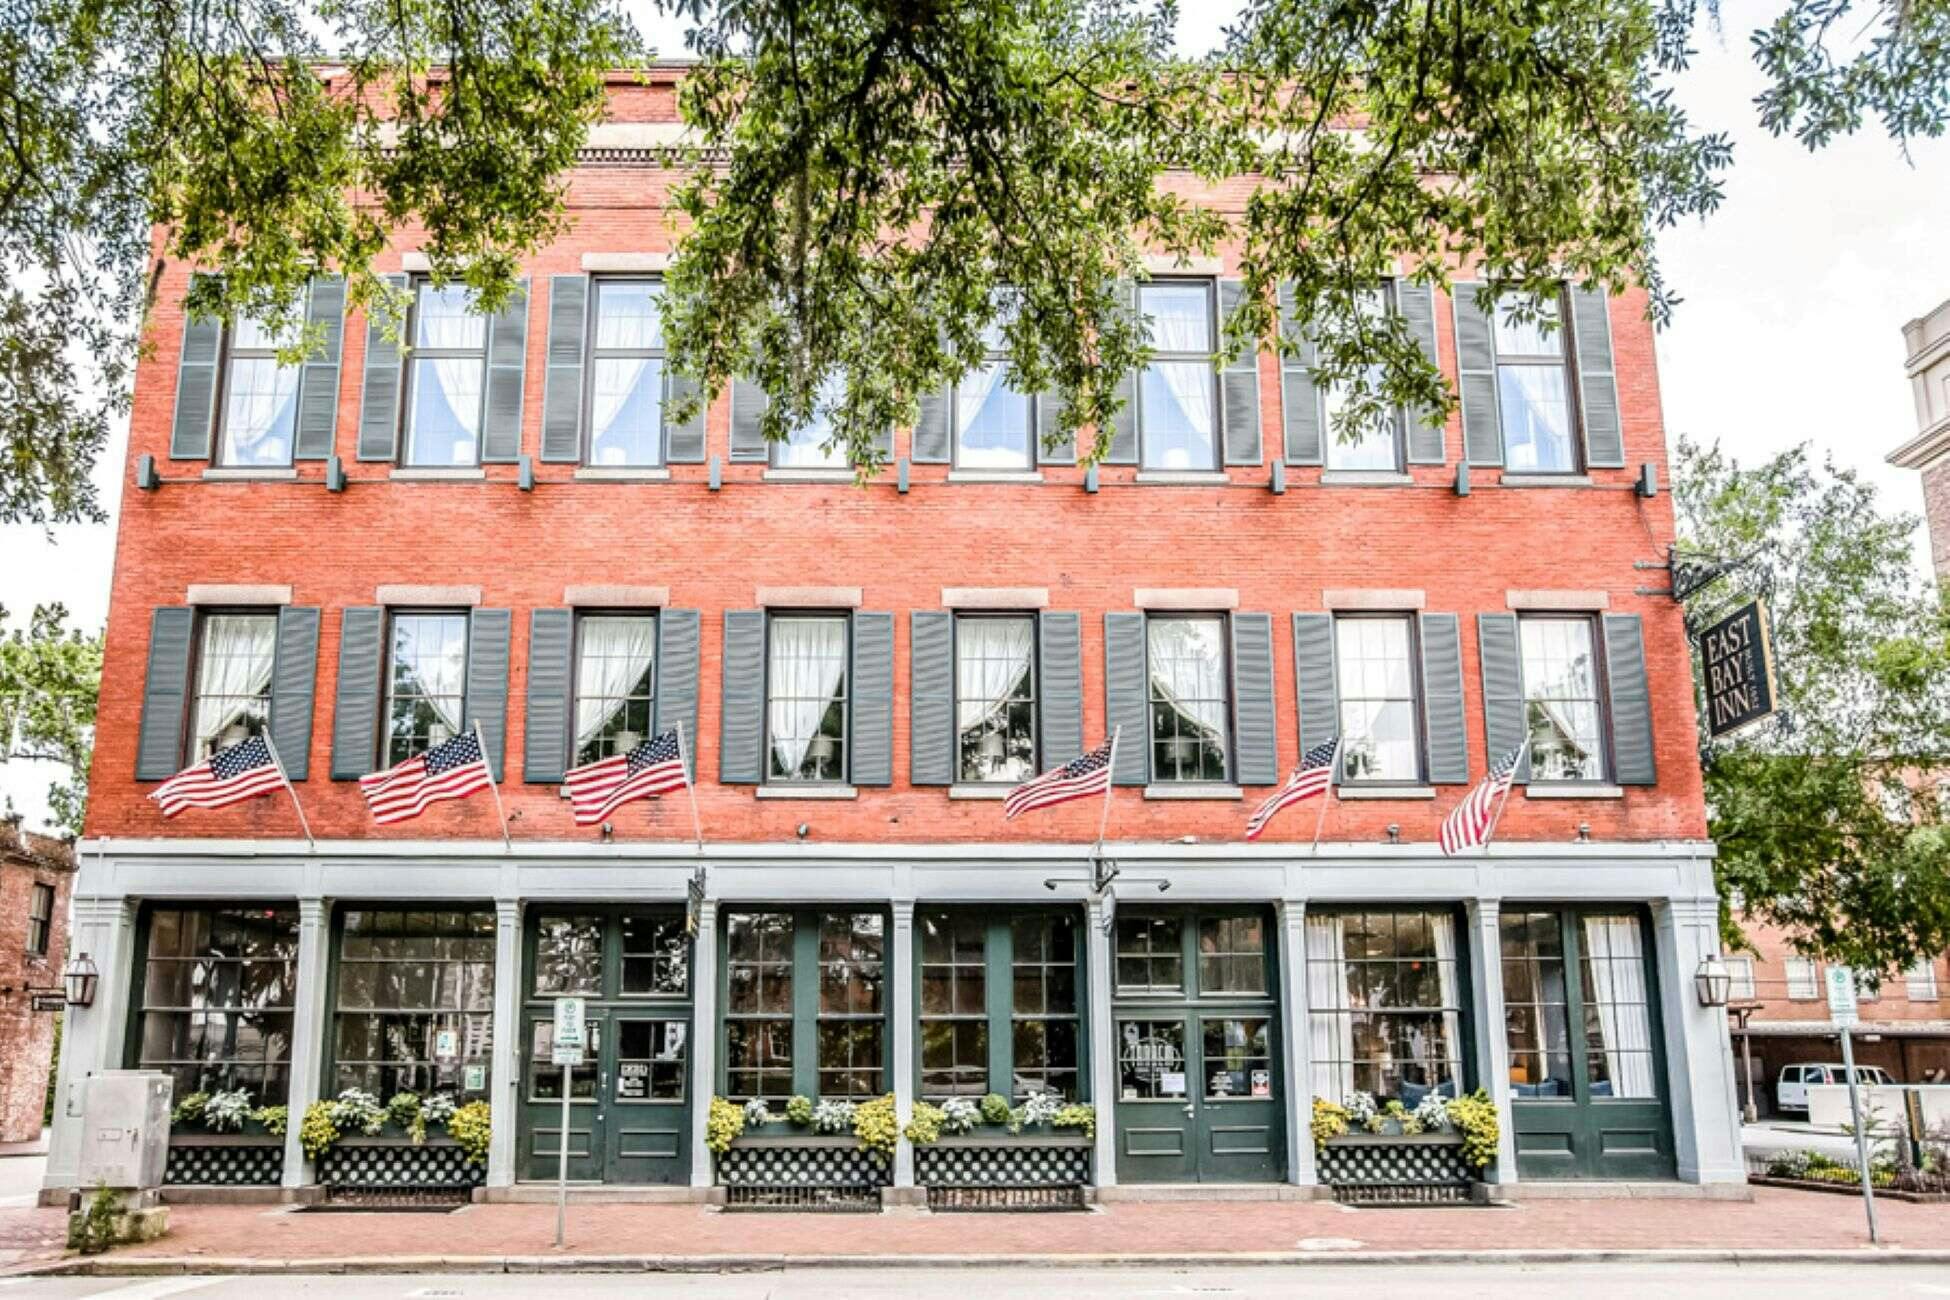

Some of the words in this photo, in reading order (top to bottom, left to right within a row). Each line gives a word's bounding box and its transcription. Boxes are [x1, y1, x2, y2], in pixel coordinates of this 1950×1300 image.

[1706, 613, 1750, 665] EAST
[1710, 653, 1743, 695] BAY
[1713, 684, 1751, 726] INN
